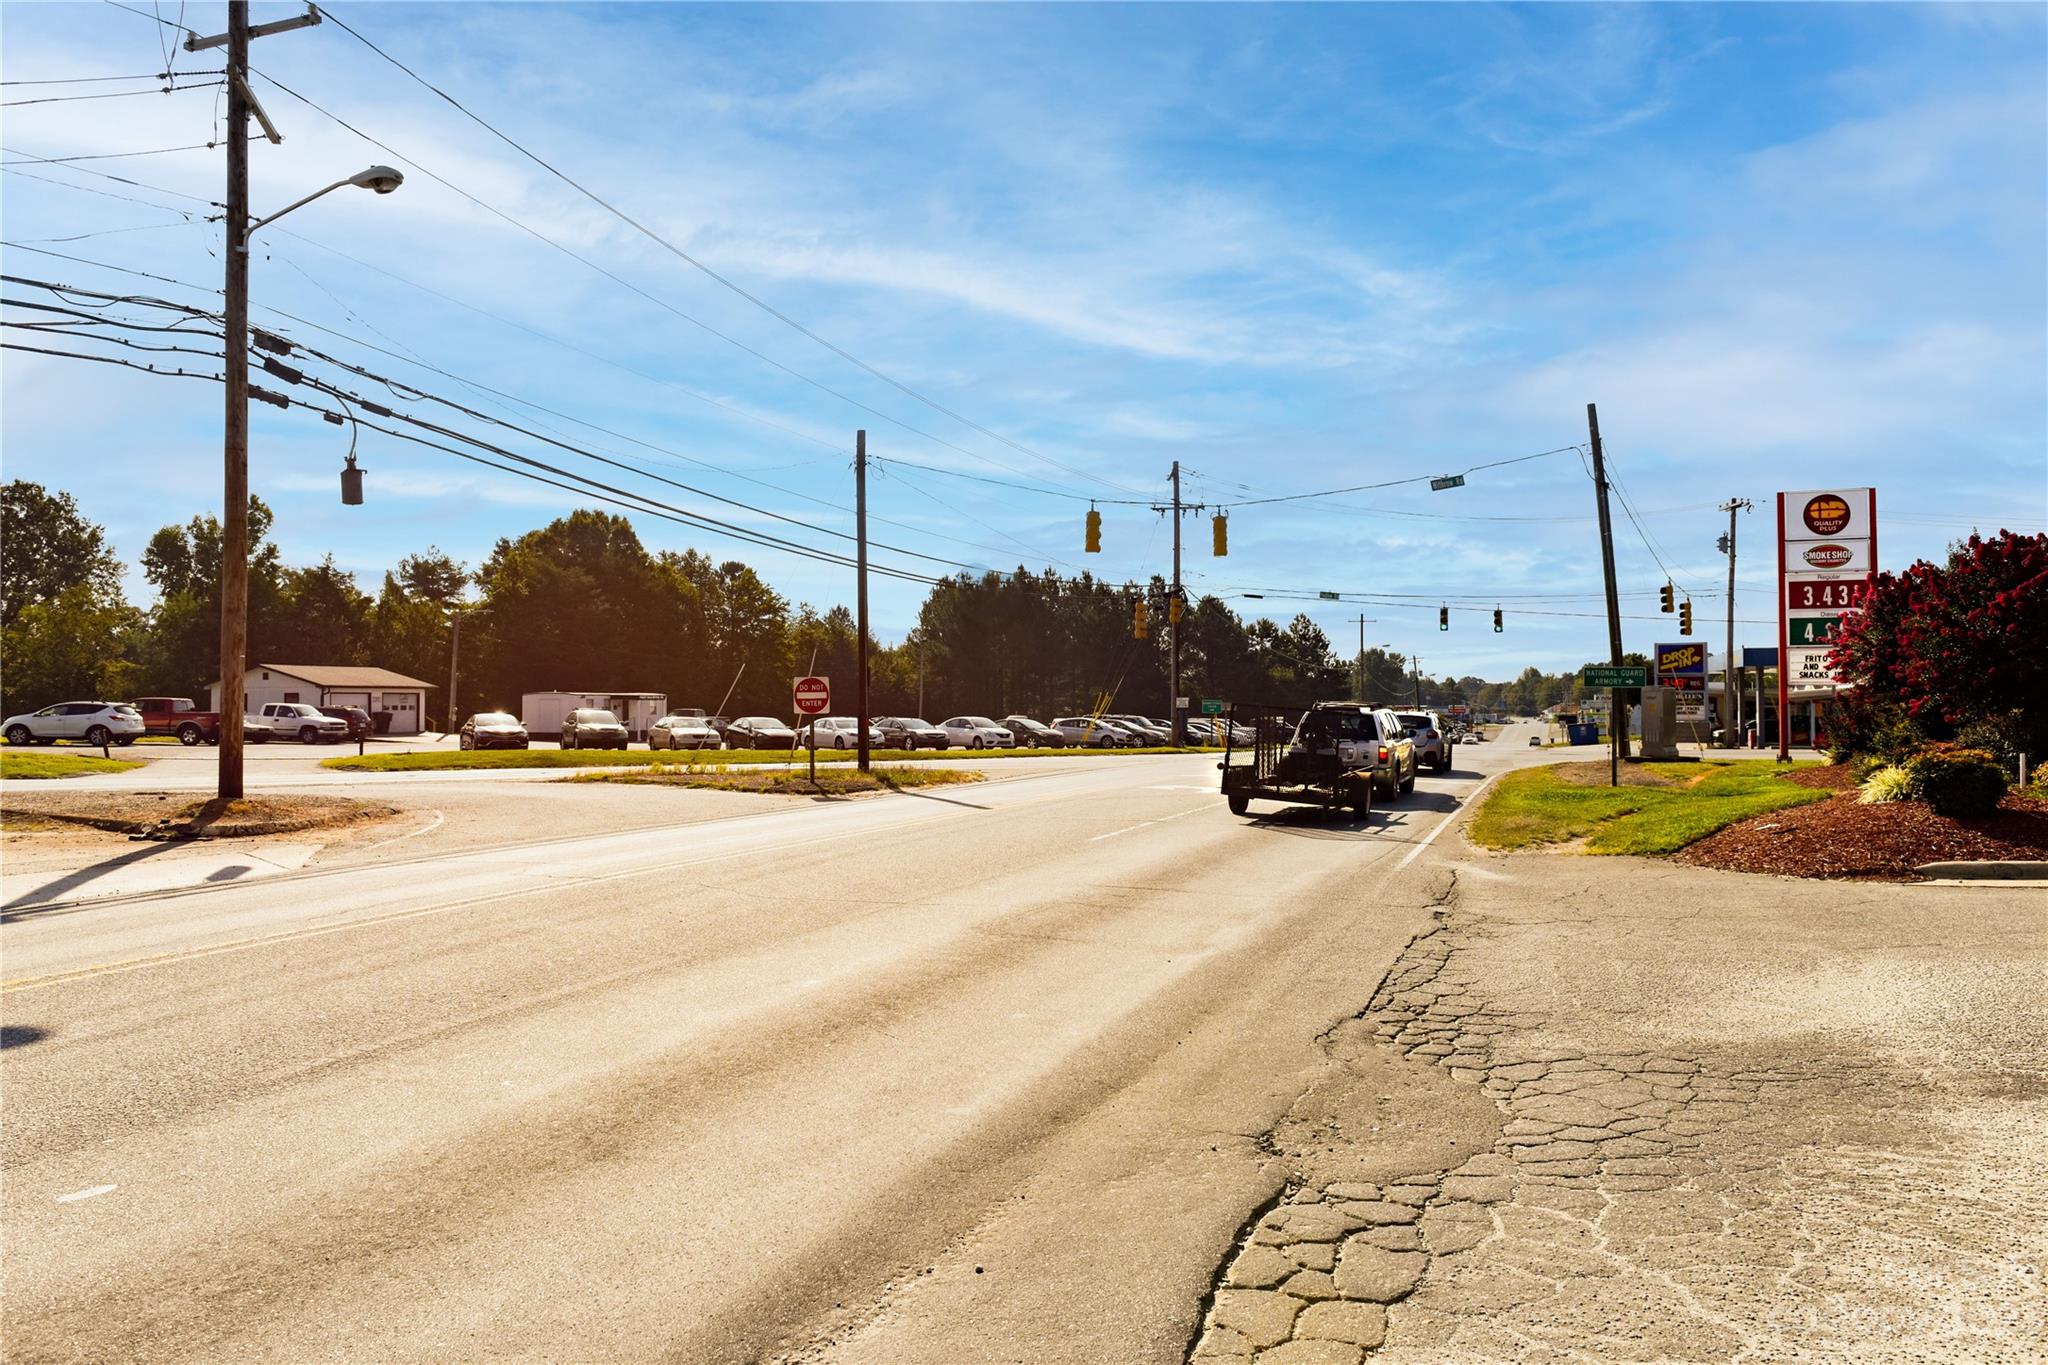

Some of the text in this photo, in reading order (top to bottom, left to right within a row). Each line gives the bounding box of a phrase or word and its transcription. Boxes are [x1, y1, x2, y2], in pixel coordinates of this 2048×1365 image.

[1803, 550, 1853, 560] SMOKE SHOP
[1663, 647, 1695, 664] DROP
[1679, 656, 1692, 668] IN
